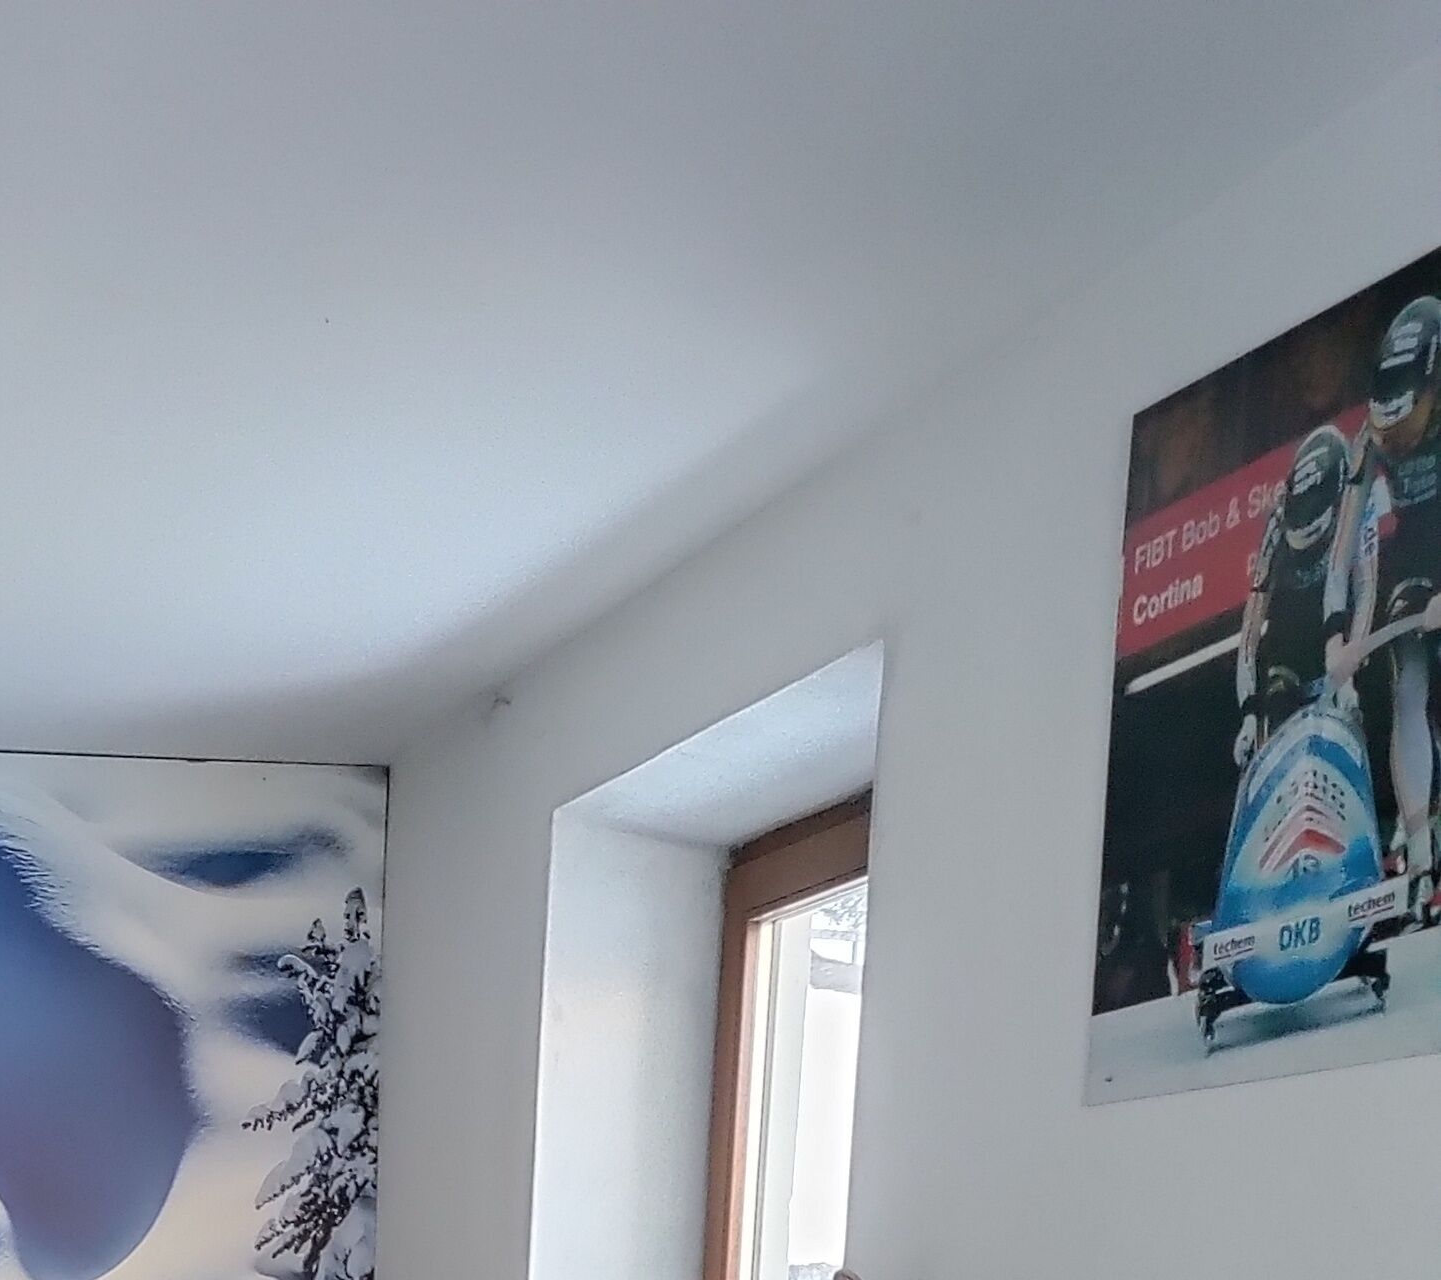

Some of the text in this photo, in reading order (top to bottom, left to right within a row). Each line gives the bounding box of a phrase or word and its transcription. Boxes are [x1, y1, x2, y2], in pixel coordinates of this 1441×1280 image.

[1134, 528, 1178, 575] FIBT
[1182, 510, 1221, 553] Bob
[1225, 496, 1241, 529] &
[1132, 574, 1204, 626] Cortina
[1278, 916, 1322, 951] DKB
